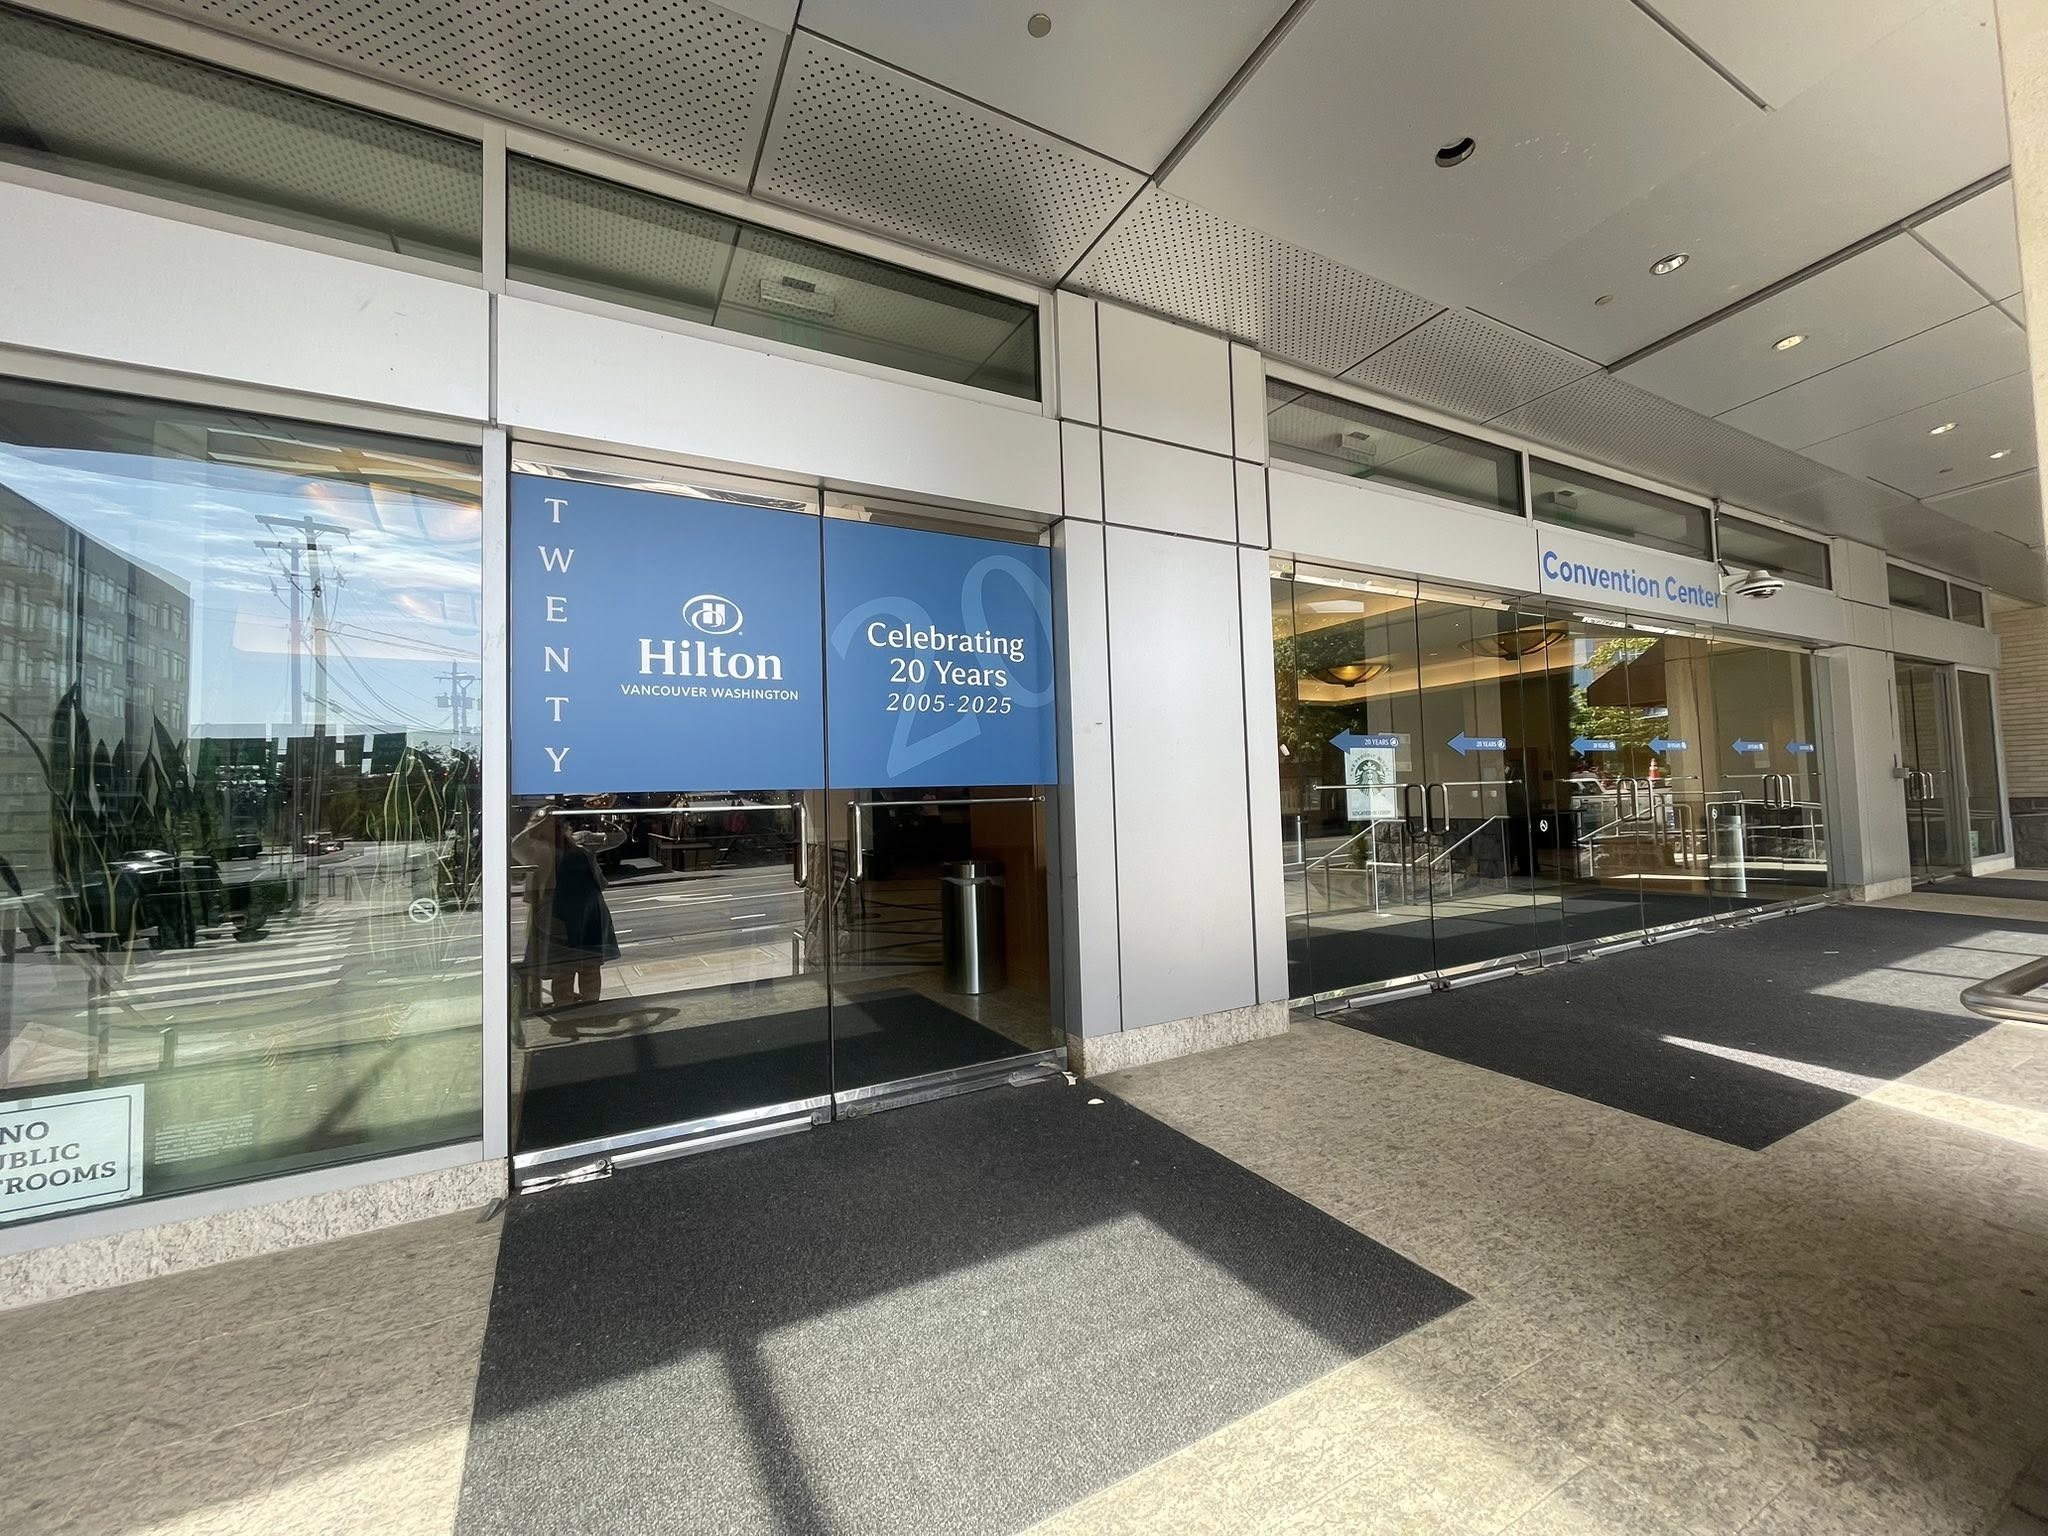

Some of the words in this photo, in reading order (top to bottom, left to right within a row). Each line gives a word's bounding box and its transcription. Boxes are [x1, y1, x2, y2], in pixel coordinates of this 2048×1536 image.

[1542, 550, 1660, 599] Convention
[1664, 576, 1721, 609] Center
[538, 497, 575, 773] TWENTY
[867, 622, 1025, 662] Celebrating
[638, 638, 783, 681] Hilton
[889, 658, 926, 683] 20
[933, 660, 1008, 687] Years
[621, 684, 708, 698] VANCOUVER
[711, 687, 799, 701] WASHINGTON
[886, 692, 1012, 714] 2005-2025
[1364, 738, 1371, 746] 20
[1372, 738, 1389, 746] YEARS
[0, 1121, 50, 1145] NO
[0, 1161, 117, 1195] ROOMS
